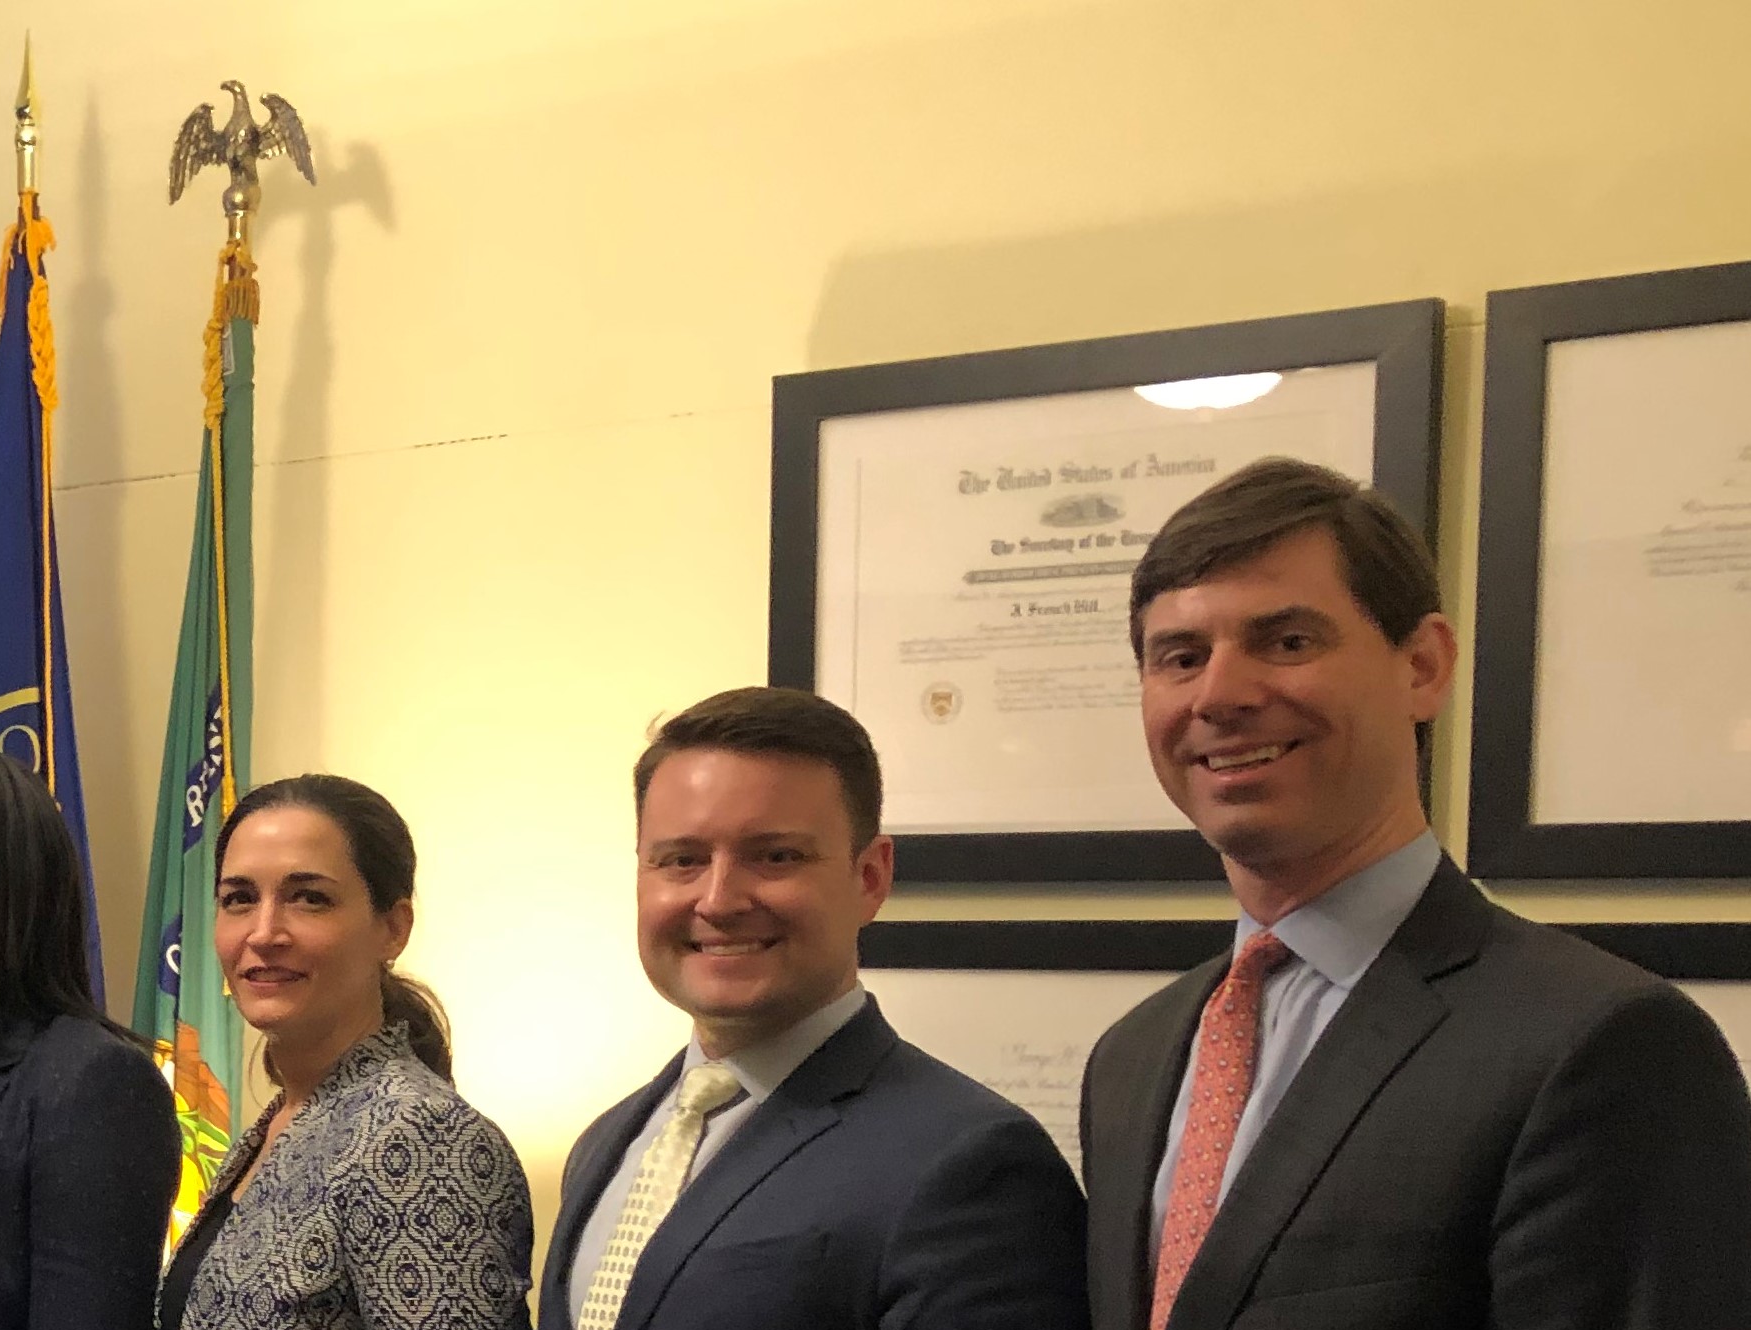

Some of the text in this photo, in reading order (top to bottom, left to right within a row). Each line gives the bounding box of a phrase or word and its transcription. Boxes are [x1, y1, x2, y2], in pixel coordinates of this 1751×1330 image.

[958, 452, 1218, 495] The United States of America
[990, 538, 1016, 556] The
